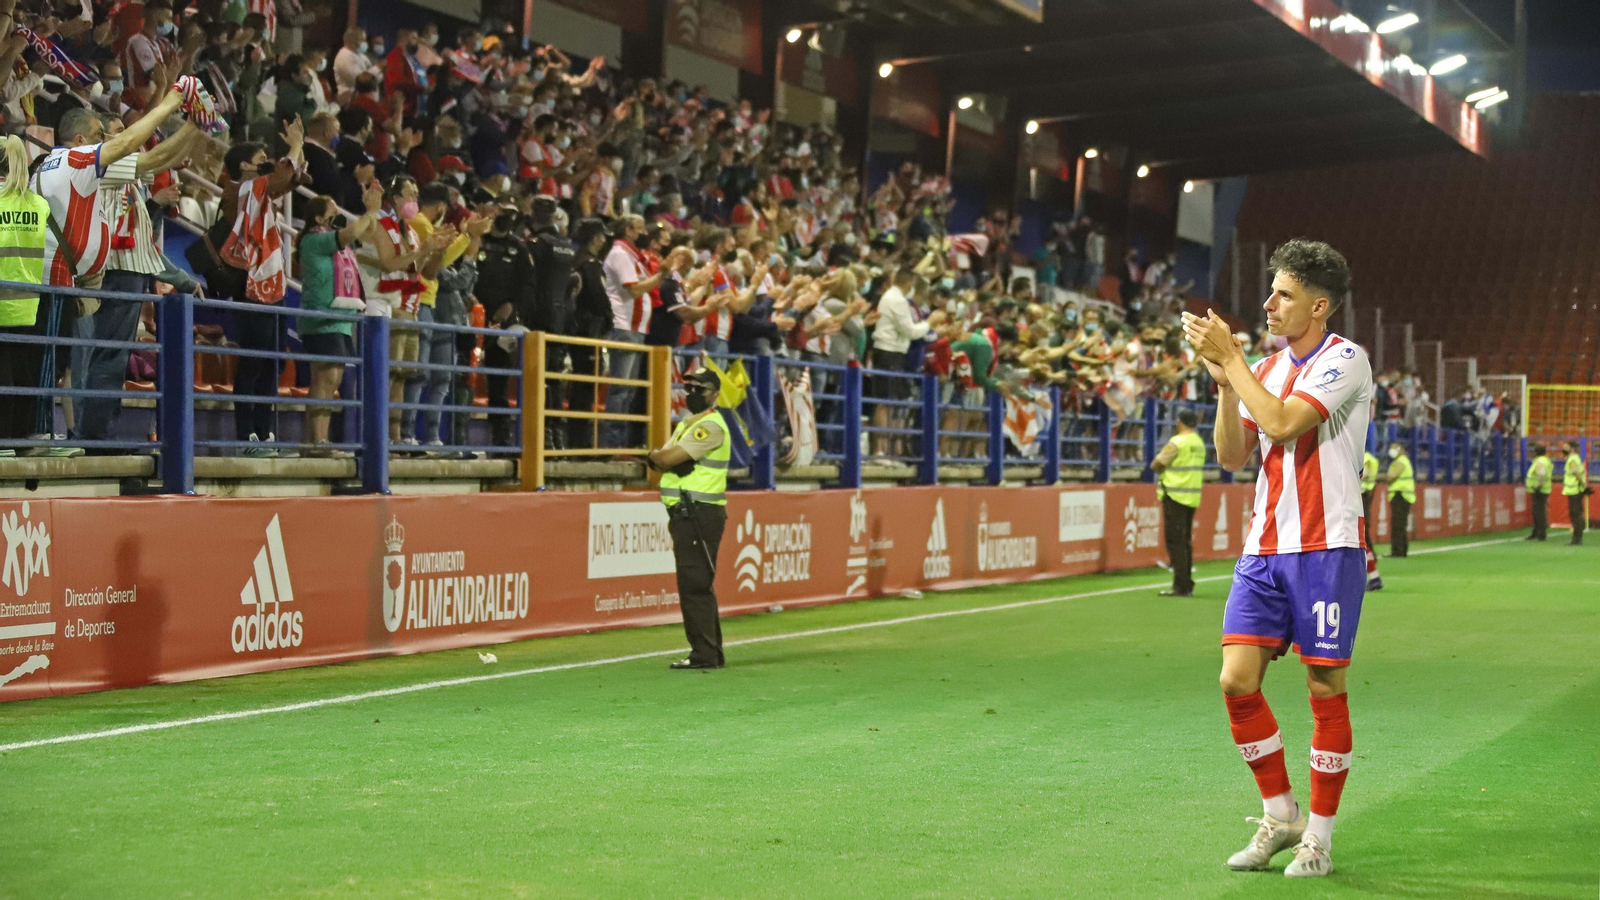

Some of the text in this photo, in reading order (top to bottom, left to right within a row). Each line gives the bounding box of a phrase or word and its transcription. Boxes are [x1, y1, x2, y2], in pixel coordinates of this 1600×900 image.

[591, 524, 615, 561] JUNTA
[619, 523, 629, 554] DE
[764, 514, 811, 553] DIPUTACIÓN
[411, 550, 464, 575] AYUNTAMIENTO
[773, 552, 810, 583] BADAJOZ
[0, 600, 51, 618] Extremadura
[65, 584, 137, 607] Dirección General
[405, 571, 529, 631] ALMENDRALEJO
[64, 618, 115, 642] de Deportes
[231, 601, 303, 653] adidas
[1311, 600, 1341, 639] 19
[15, 640, 33, 654] desde
[34, 639, 40, 652] la
[41, 639, 55, 651] Base
